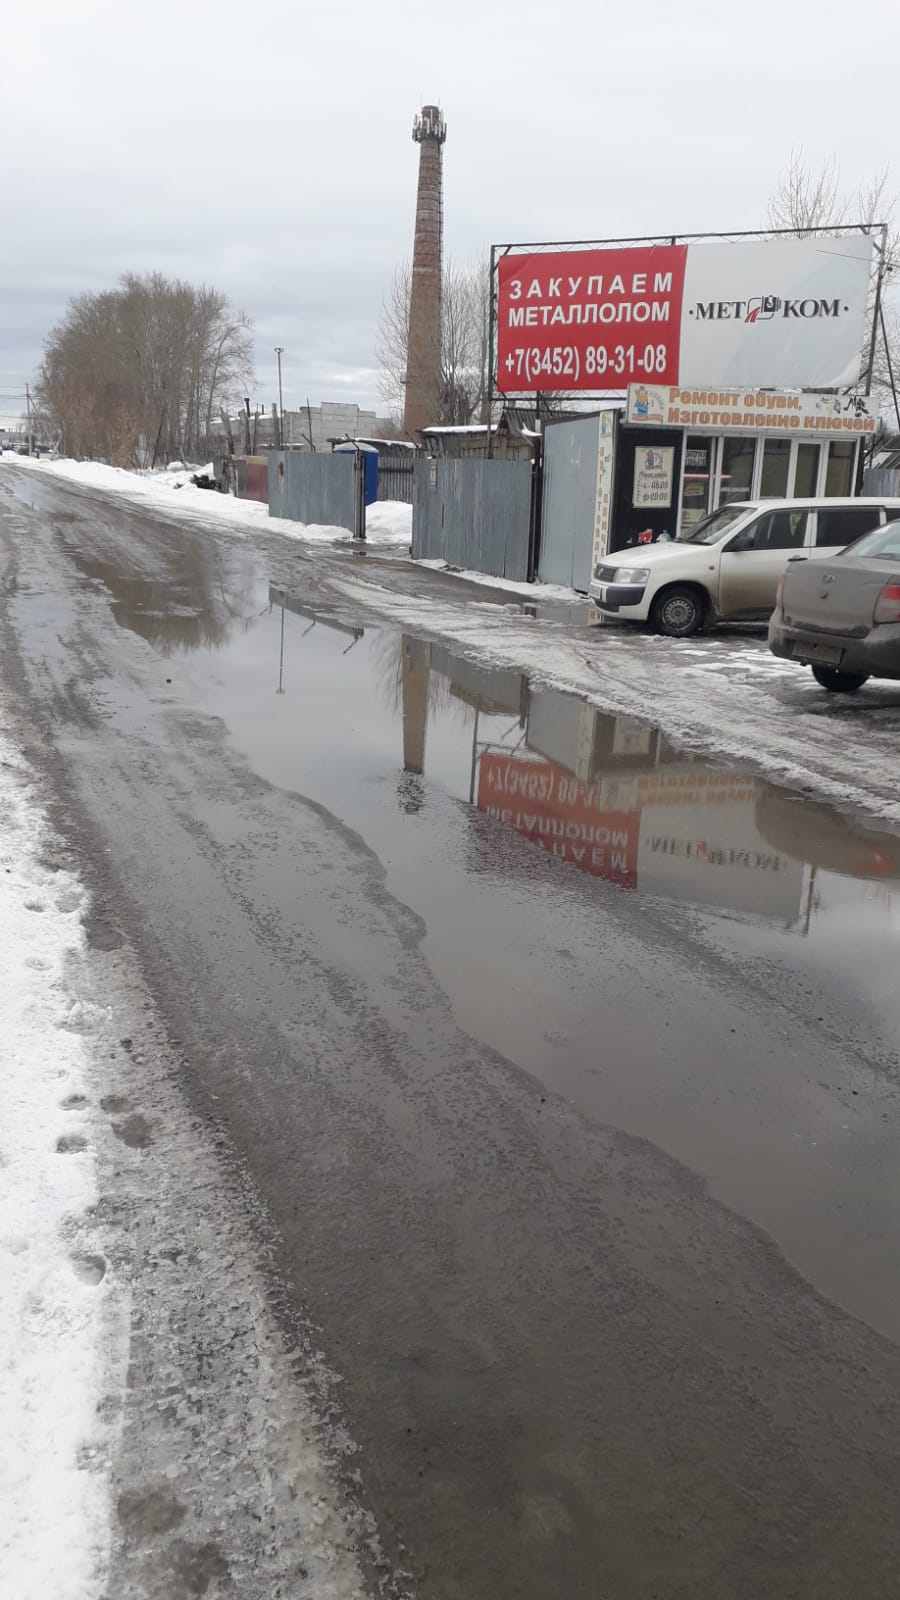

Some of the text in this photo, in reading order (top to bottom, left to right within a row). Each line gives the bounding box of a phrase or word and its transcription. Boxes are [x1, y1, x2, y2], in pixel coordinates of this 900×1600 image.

[508, 272, 673, 300] ЗАКУПАЕМ
[508, 301, 671, 328] МЕТАЛЛОЛОМ
[505, 343, 667, 383] +7(3452) 89-31-08
[668, 388, 740, 408] Ремонт
[667, 407, 800, 428] Изготовление
[803, 415, 875, 431] ключей
